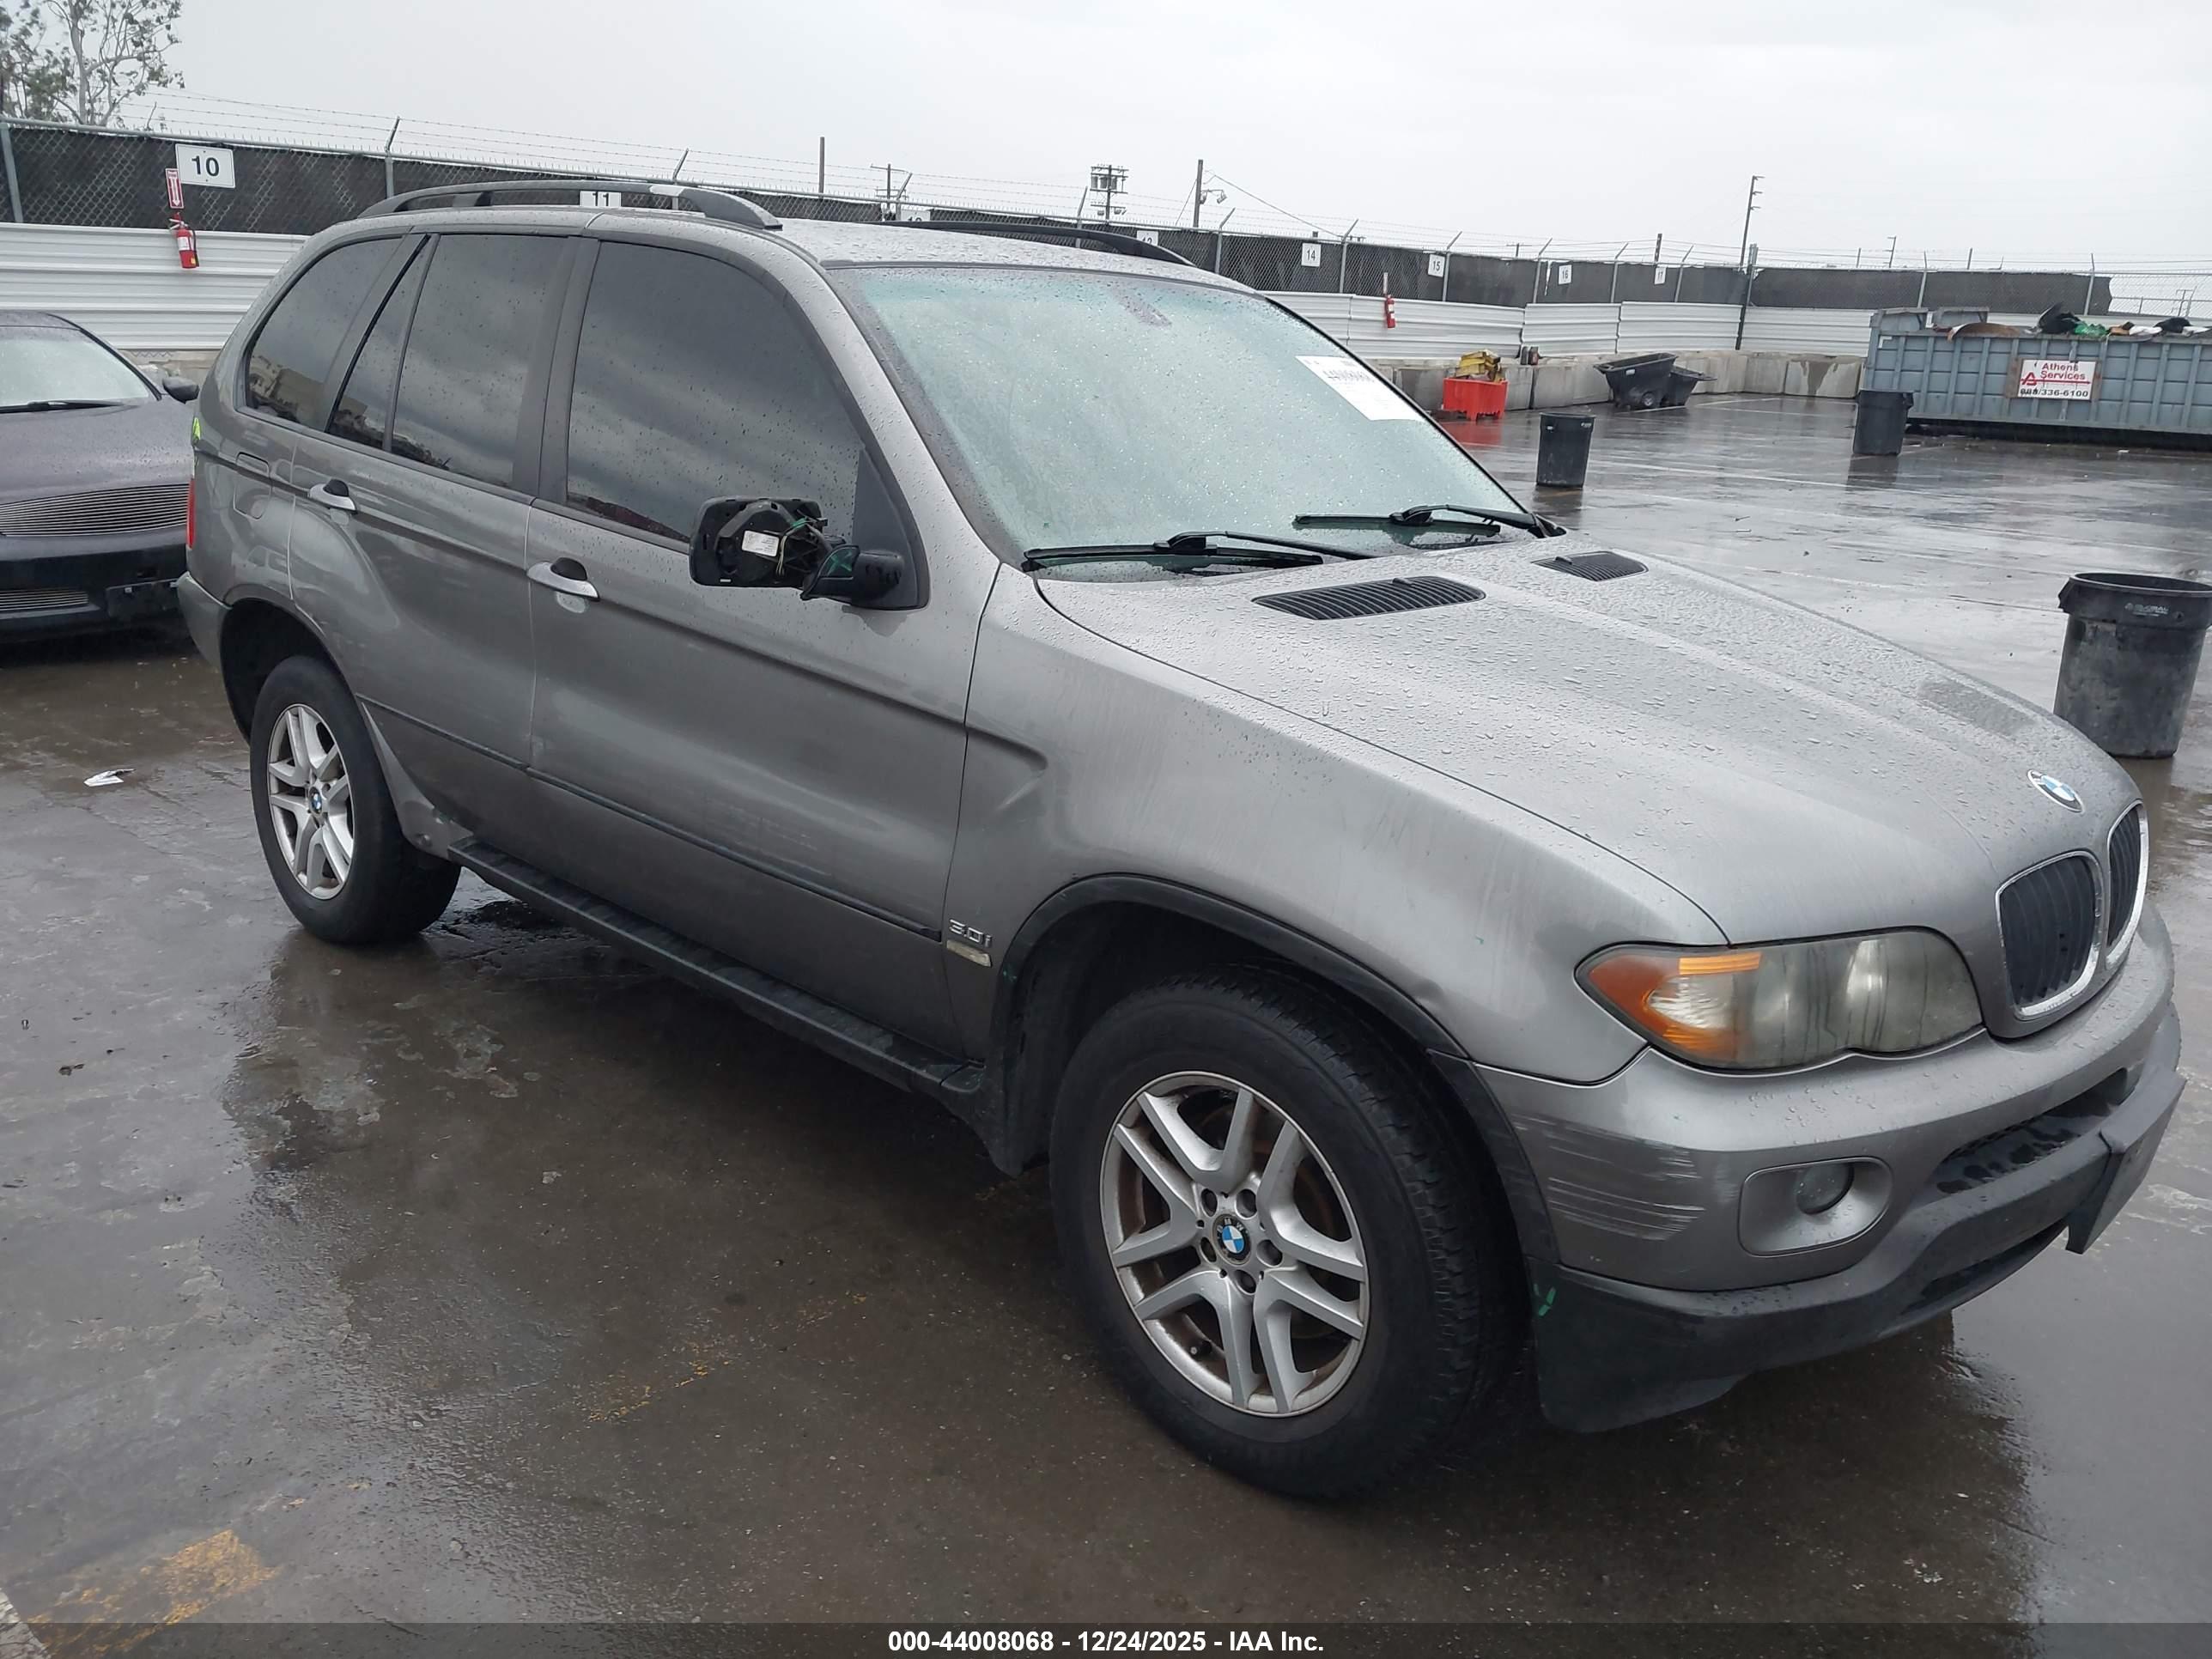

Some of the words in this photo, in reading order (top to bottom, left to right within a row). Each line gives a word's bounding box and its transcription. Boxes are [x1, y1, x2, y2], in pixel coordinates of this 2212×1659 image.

[191, 155, 220, 177] 10
[592, 191, 609, 206] 11
[1307, 249, 1316, 261] 14
[1433, 260, 1441, 271] 15
[1562, 269, 1569, 280] 16
[2041, 362, 2079, 372] Athens
[2040, 370, 2086, 380] Services
